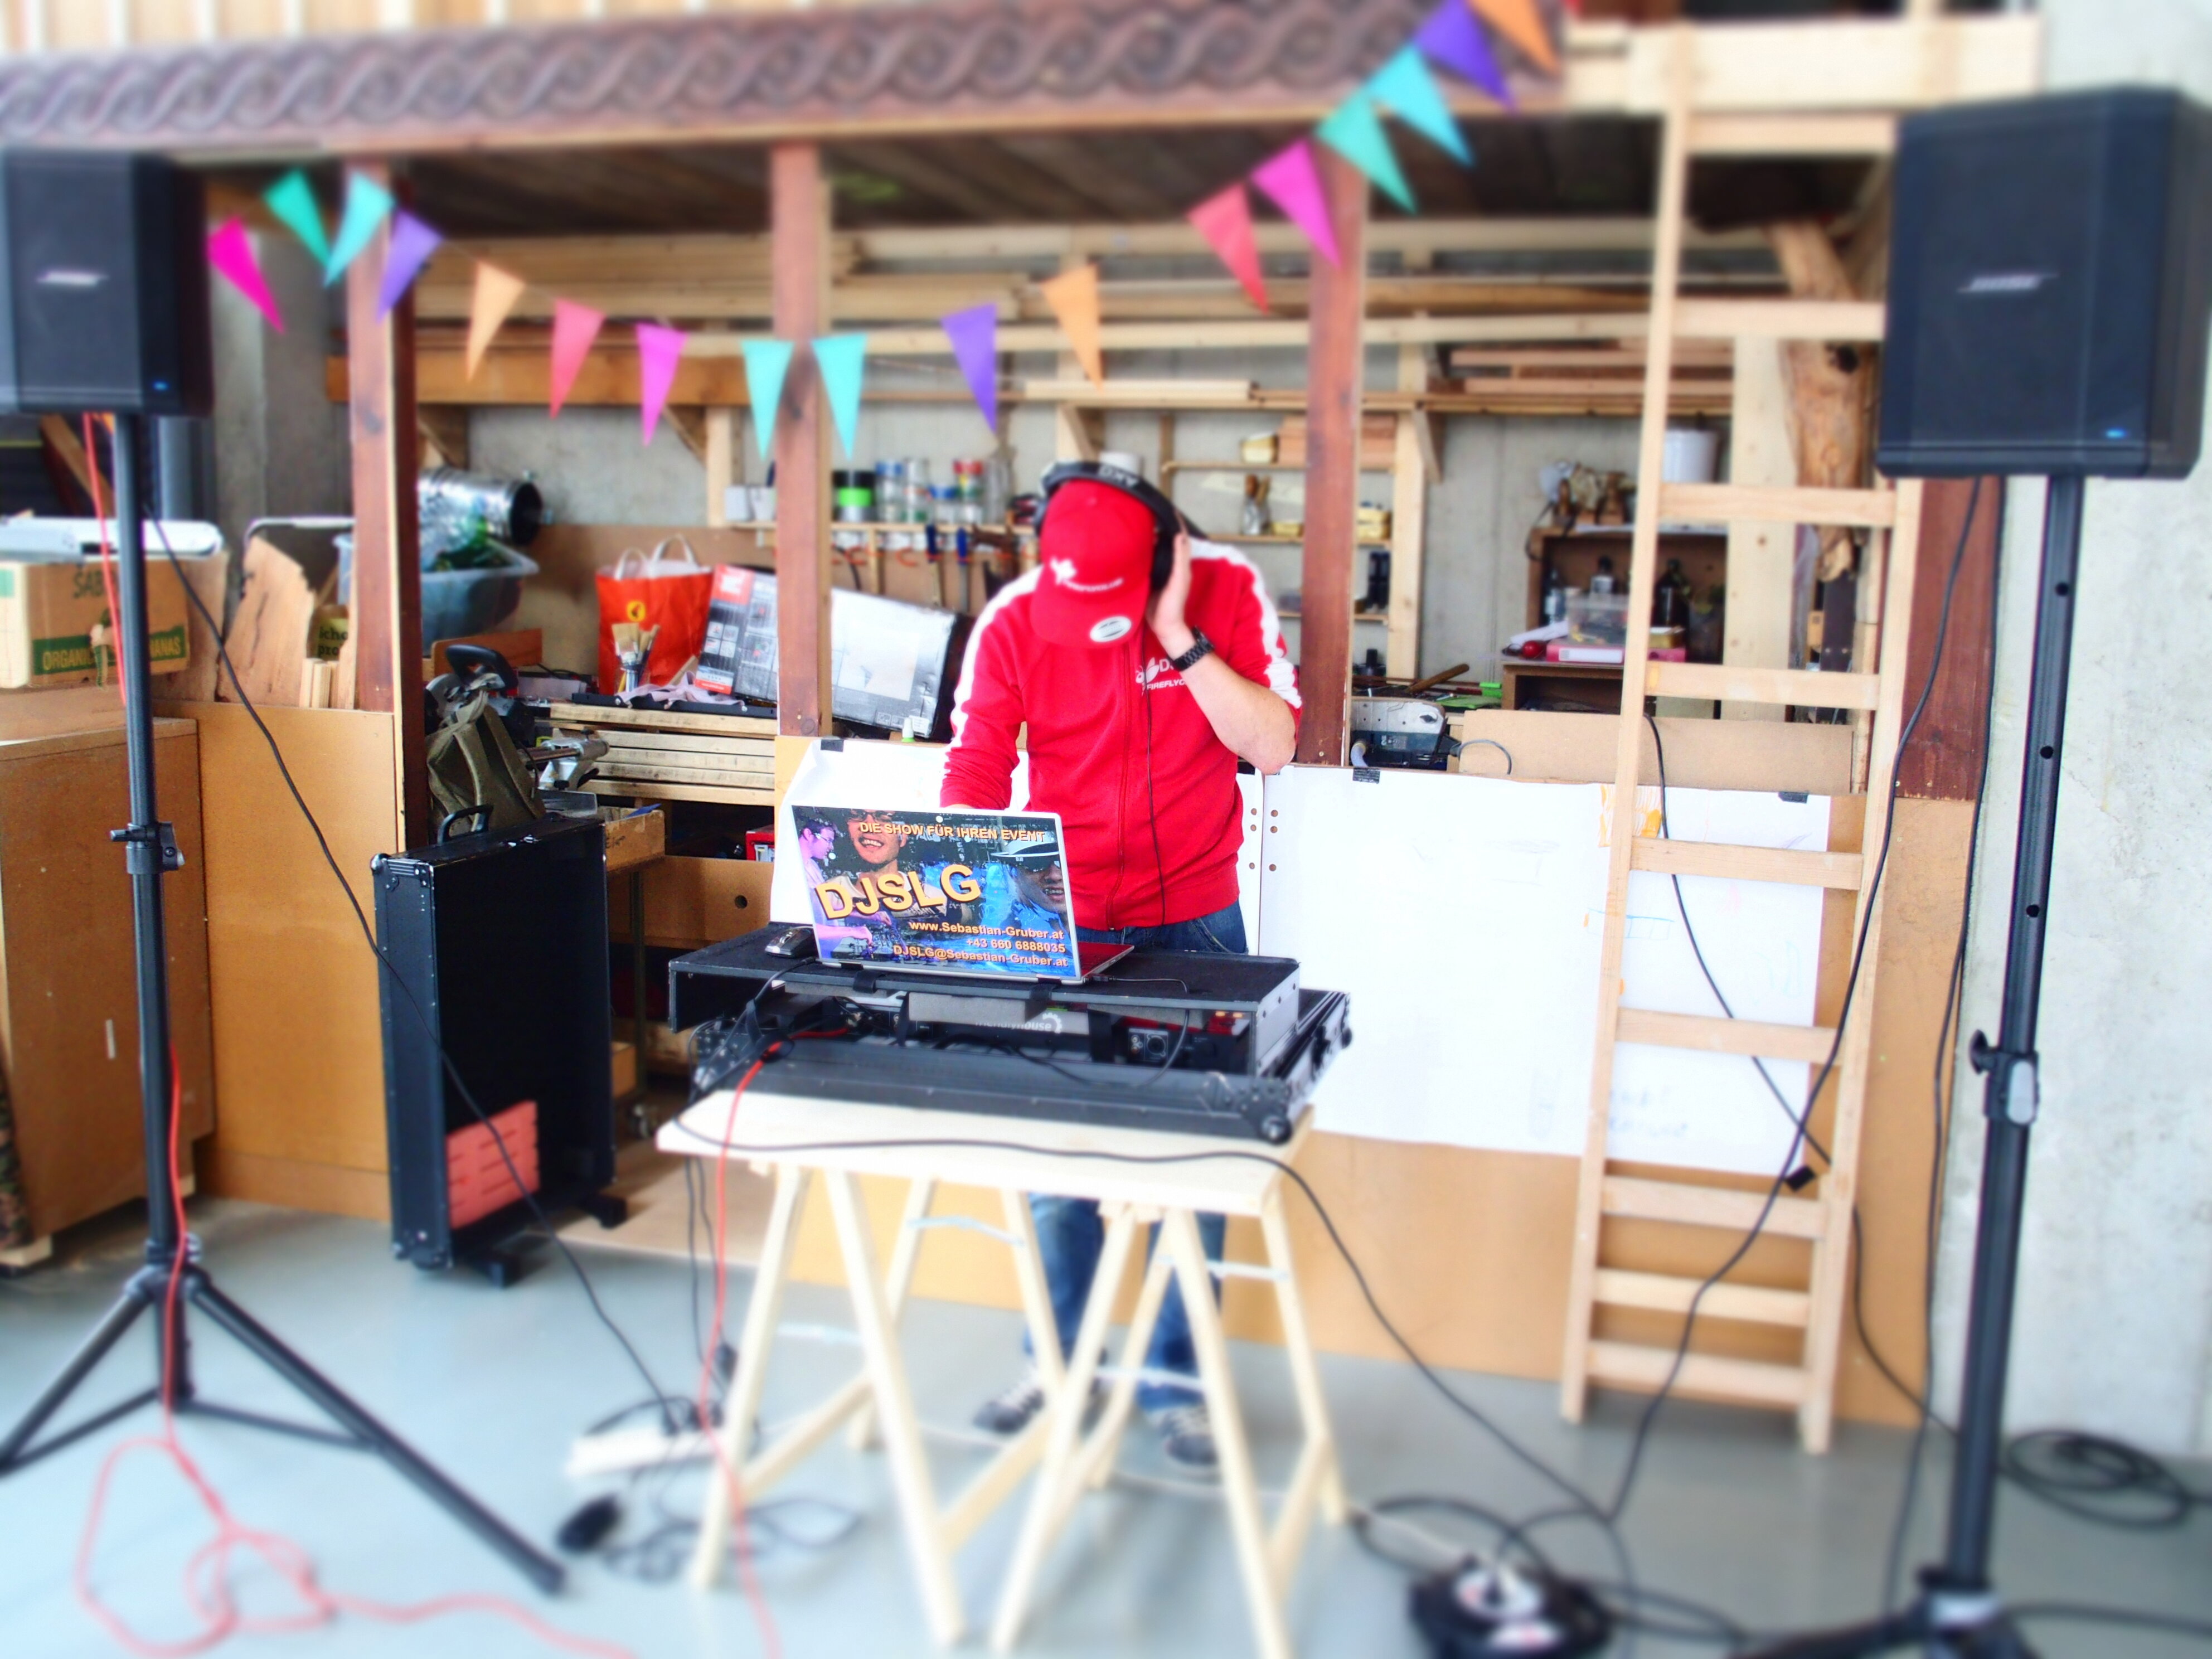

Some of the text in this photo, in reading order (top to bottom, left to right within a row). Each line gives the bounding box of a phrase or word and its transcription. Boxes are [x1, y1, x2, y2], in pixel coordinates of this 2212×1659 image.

[860, 822, 1045, 842] DIE SHOW FÜR IHREN EVENT
[816, 864, 981, 919] DJSLG
[909, 921, 1065, 939] www.Sebastian-Gruber.at
[892, 945, 1068, 967] DJSLG@Sebastian-Gruber.at
[966, 939, 1066, 953] +43 660 6888035
